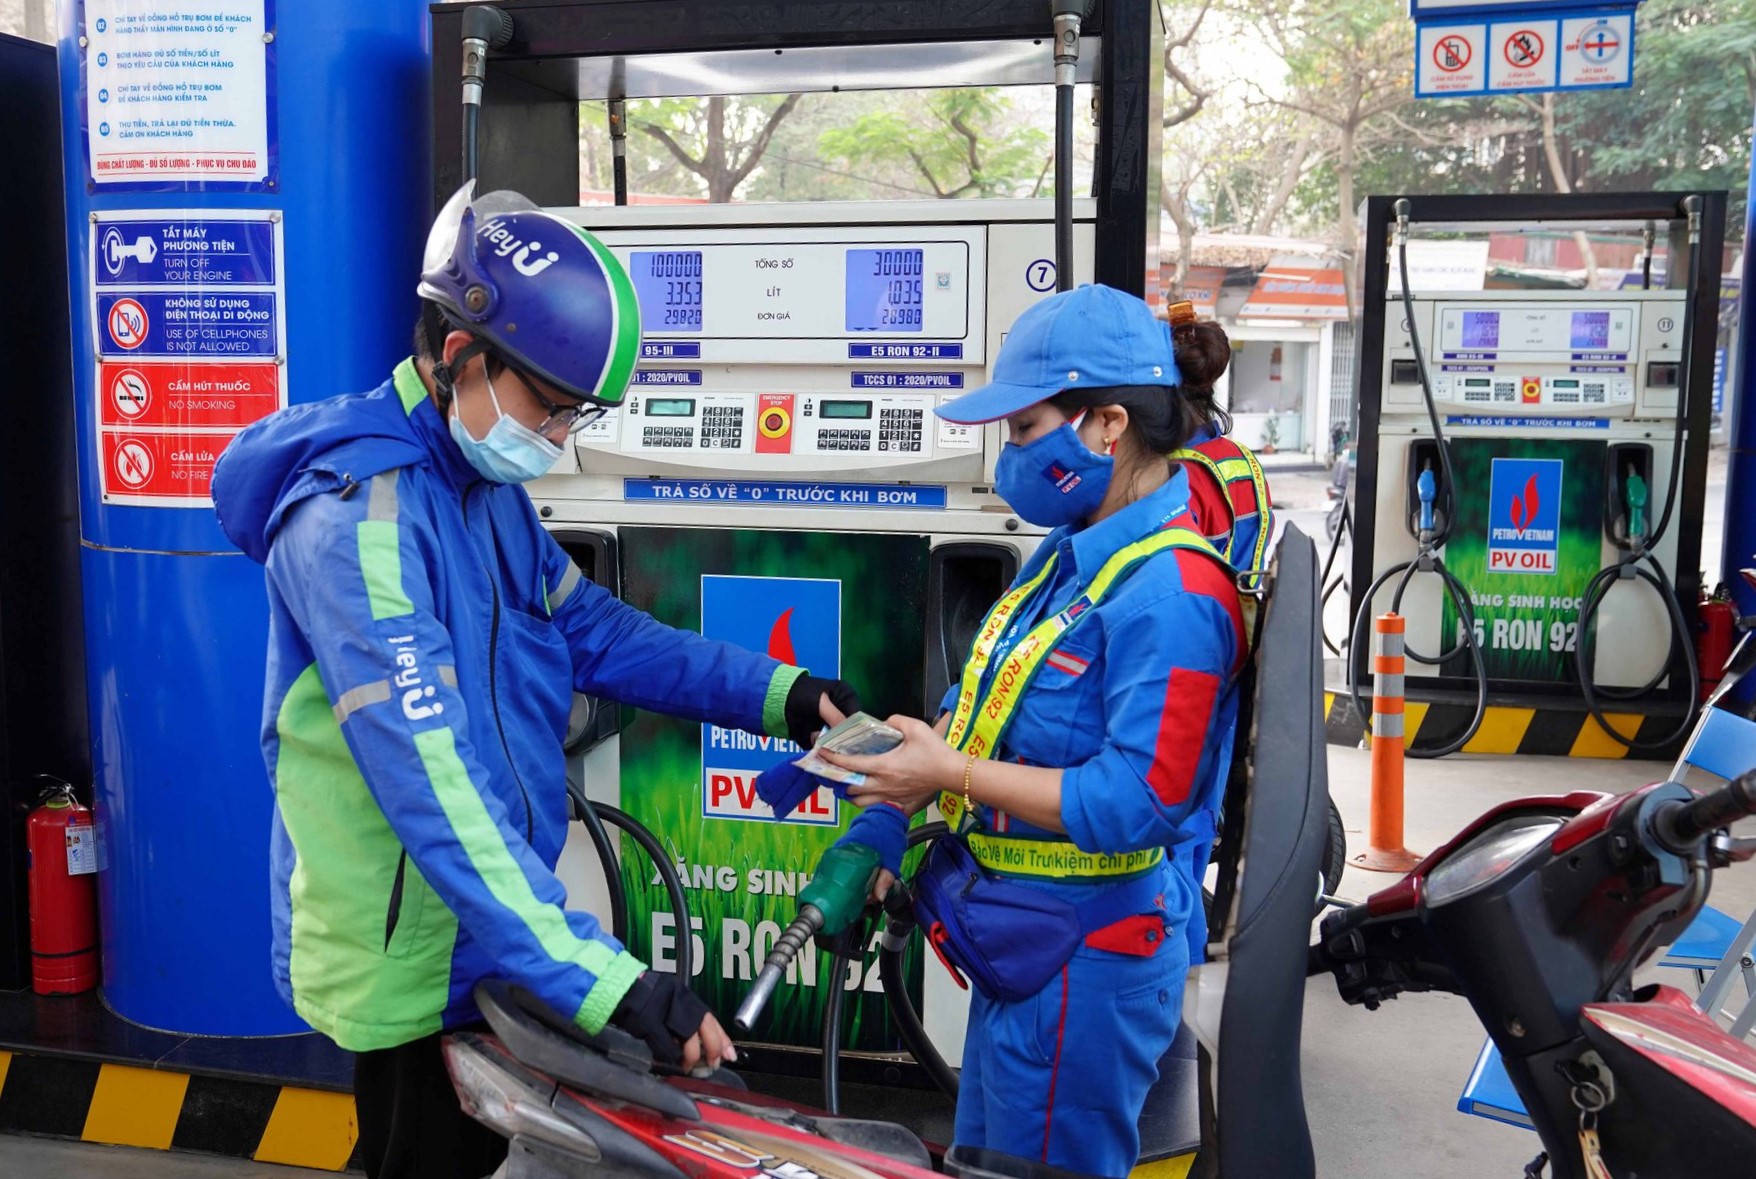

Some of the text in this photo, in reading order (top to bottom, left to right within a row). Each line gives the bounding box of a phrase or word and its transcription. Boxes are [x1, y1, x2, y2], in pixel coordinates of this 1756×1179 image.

[163, 225, 207, 238] TẮT MÁY
[163, 241, 235, 253] PHƯƠNG TIỆN
[164, 259, 210, 268] TURN OFF
[652, 254, 702, 277] 100000
[755, 258, 794, 269] TỔNG SỐ
[873, 251, 922, 276] 30000
[164, 271, 232, 280] YOUR ENGINE
[1037, 267, 1048, 283] 7
[767, 286, 781, 297] LÍT
[165, 296, 250, 311] KHÔNG SỬ DỤNG
[165, 309, 269, 322] ĐIỆN THOẠI DI ĐỘNG
[665, 309, 702, 325] 29820
[776, 311, 791, 320] GIÁ
[166, 329, 268, 339] USE OF CELLPHONES
[166, 342, 250, 351] IS NOT ALLOWED
[871, 346, 884, 356] E5
[887, 347, 910, 356] RON
[647, 372, 690, 382] 2020/PVOIL
[863, 375, 951, 386] TCCS 01 2020/PVOIL
[168, 378, 251, 391] CẤM HÚT THUỐC
[169, 401, 236, 410] NO SMOKING
[171, 450, 215, 461] CẤM LỬA
[171, 471, 208, 480] NO FIRE
[652, 483, 686, 498] TRẢ
[688, 482, 712, 499] SỐ
[716, 483, 738, 499] VỀ
[775, 486, 835, 502] TRƯỚC
[840, 490, 869, 503] KHI
[877, 491, 918, 504] BƠM
[1492, 528, 1554, 541] PETROVIETNAM
[1491, 552, 1551, 569] PV OIL
[1469, 590, 1504, 606] ĂNG
[1508, 595, 1545, 608] SINH
[1493, 619, 1542, 651] RON
[1550, 621, 1578, 652] 92
[997, 658, 1021, 700] RON
[986, 697, 1003, 720] 92
[951, 690, 973, 744] E5 RO
[942, 795, 957, 816] 92
